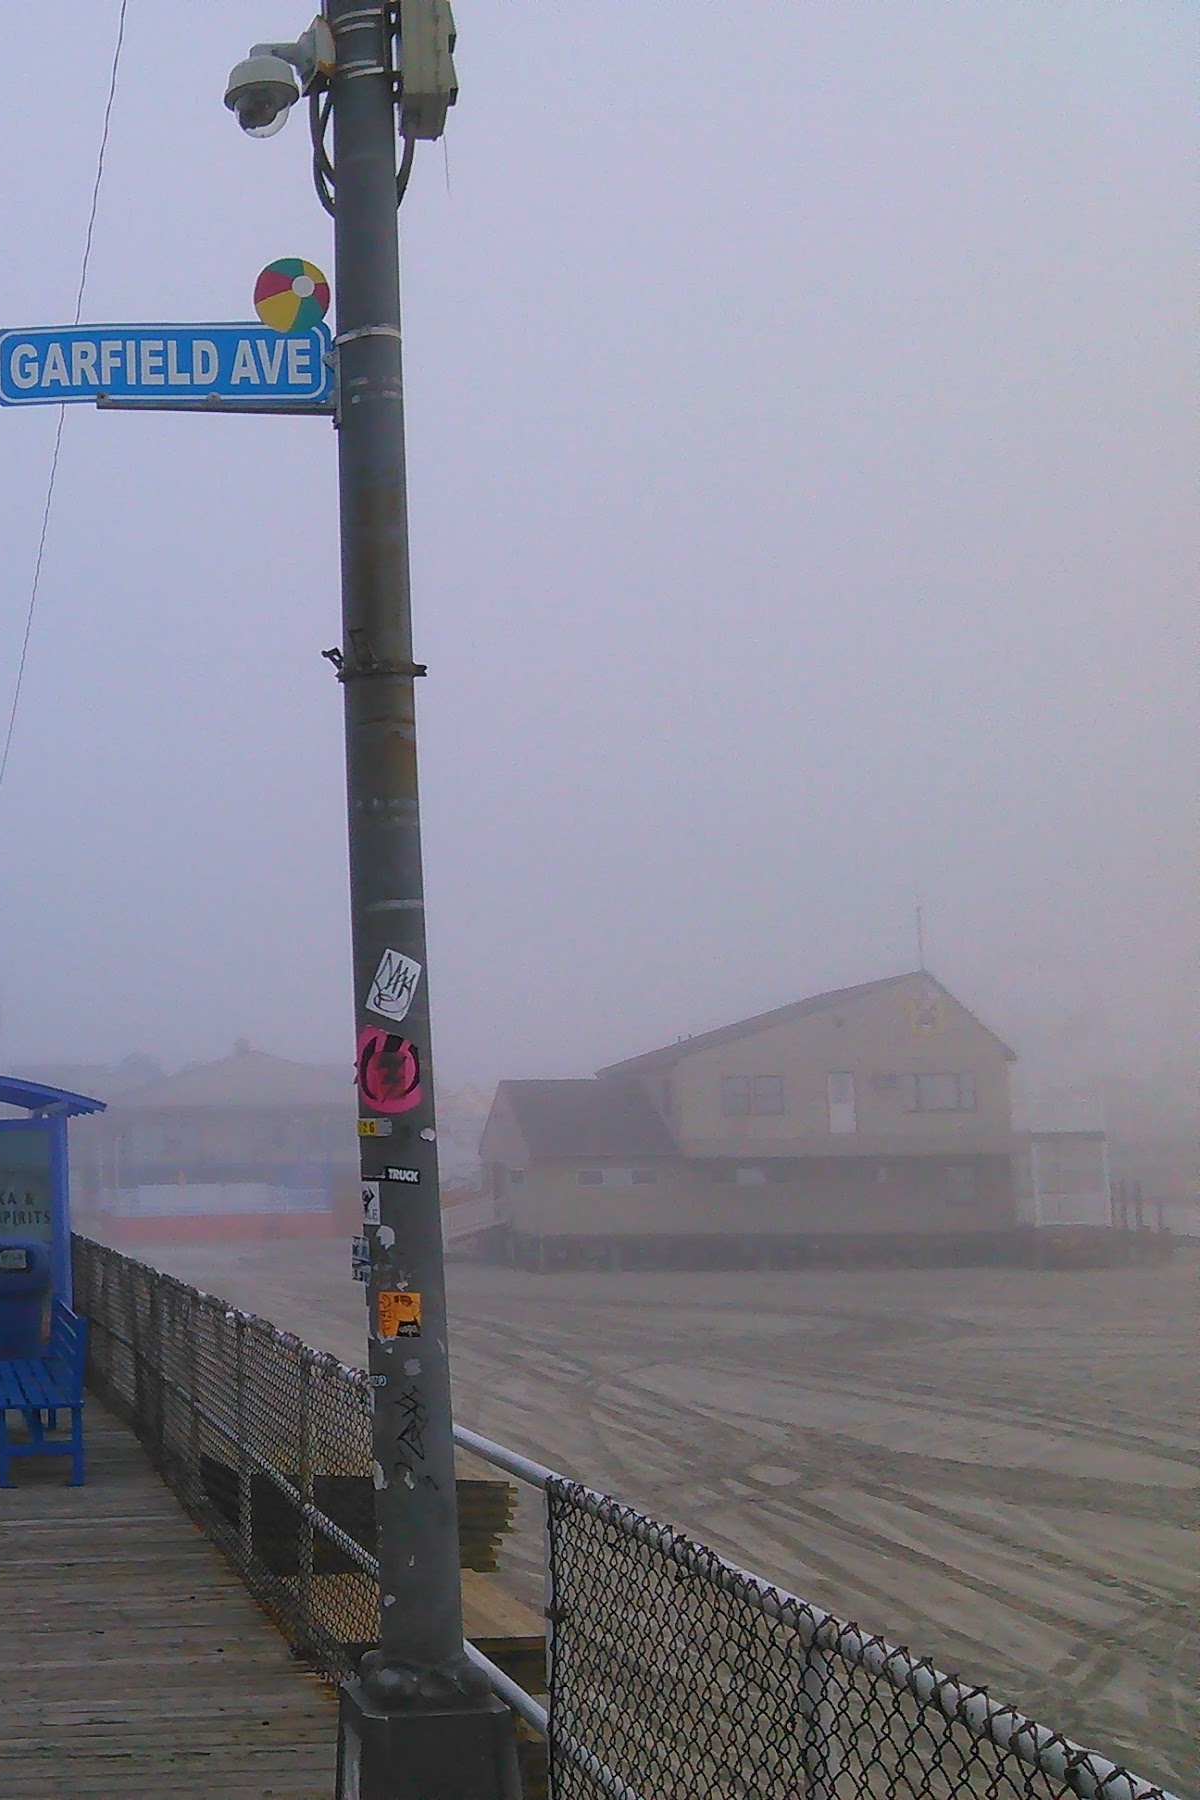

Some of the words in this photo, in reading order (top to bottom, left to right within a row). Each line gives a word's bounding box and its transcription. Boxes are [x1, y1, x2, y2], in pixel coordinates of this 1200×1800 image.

[10, 340, 218, 389] GARFIELD
[230, 339, 312, 385] AVE
[388, 1168, 418, 1182] TRUCK
